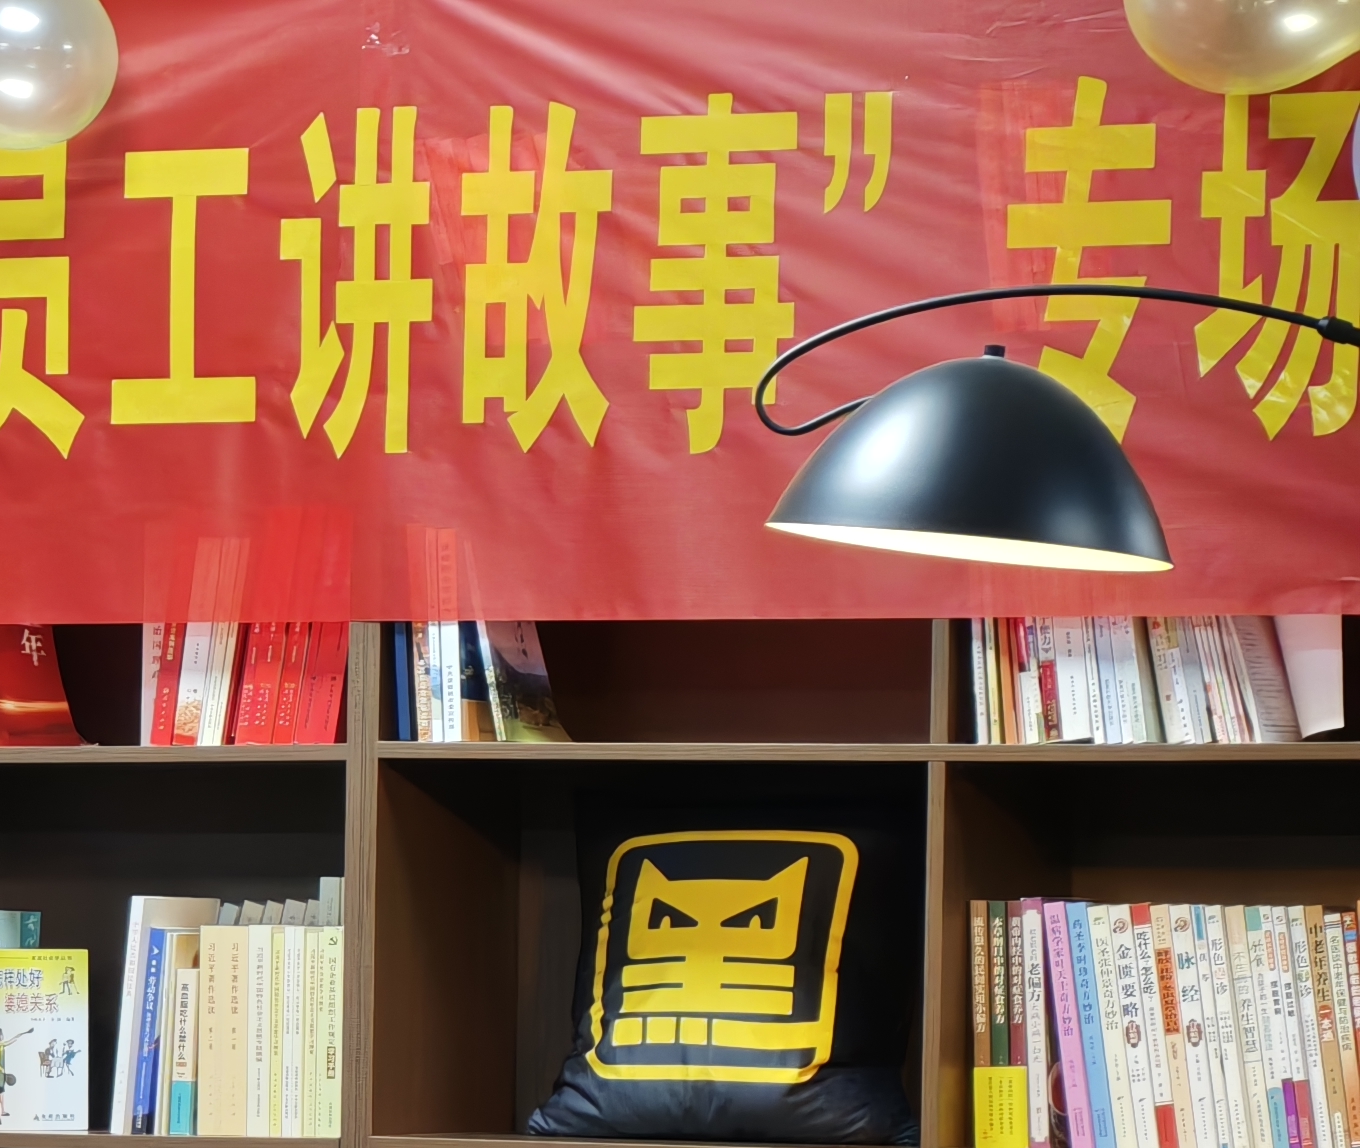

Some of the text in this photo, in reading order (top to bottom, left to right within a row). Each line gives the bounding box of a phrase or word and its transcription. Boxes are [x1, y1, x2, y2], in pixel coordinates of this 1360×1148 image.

[1006, 76, 1360, 447] 专场
[4, 993, 59, 1014] 婆媳关系
[1116, 943, 1140, 1018] 金匮要略
[1176, 951, 1200, 1003] 脉经
